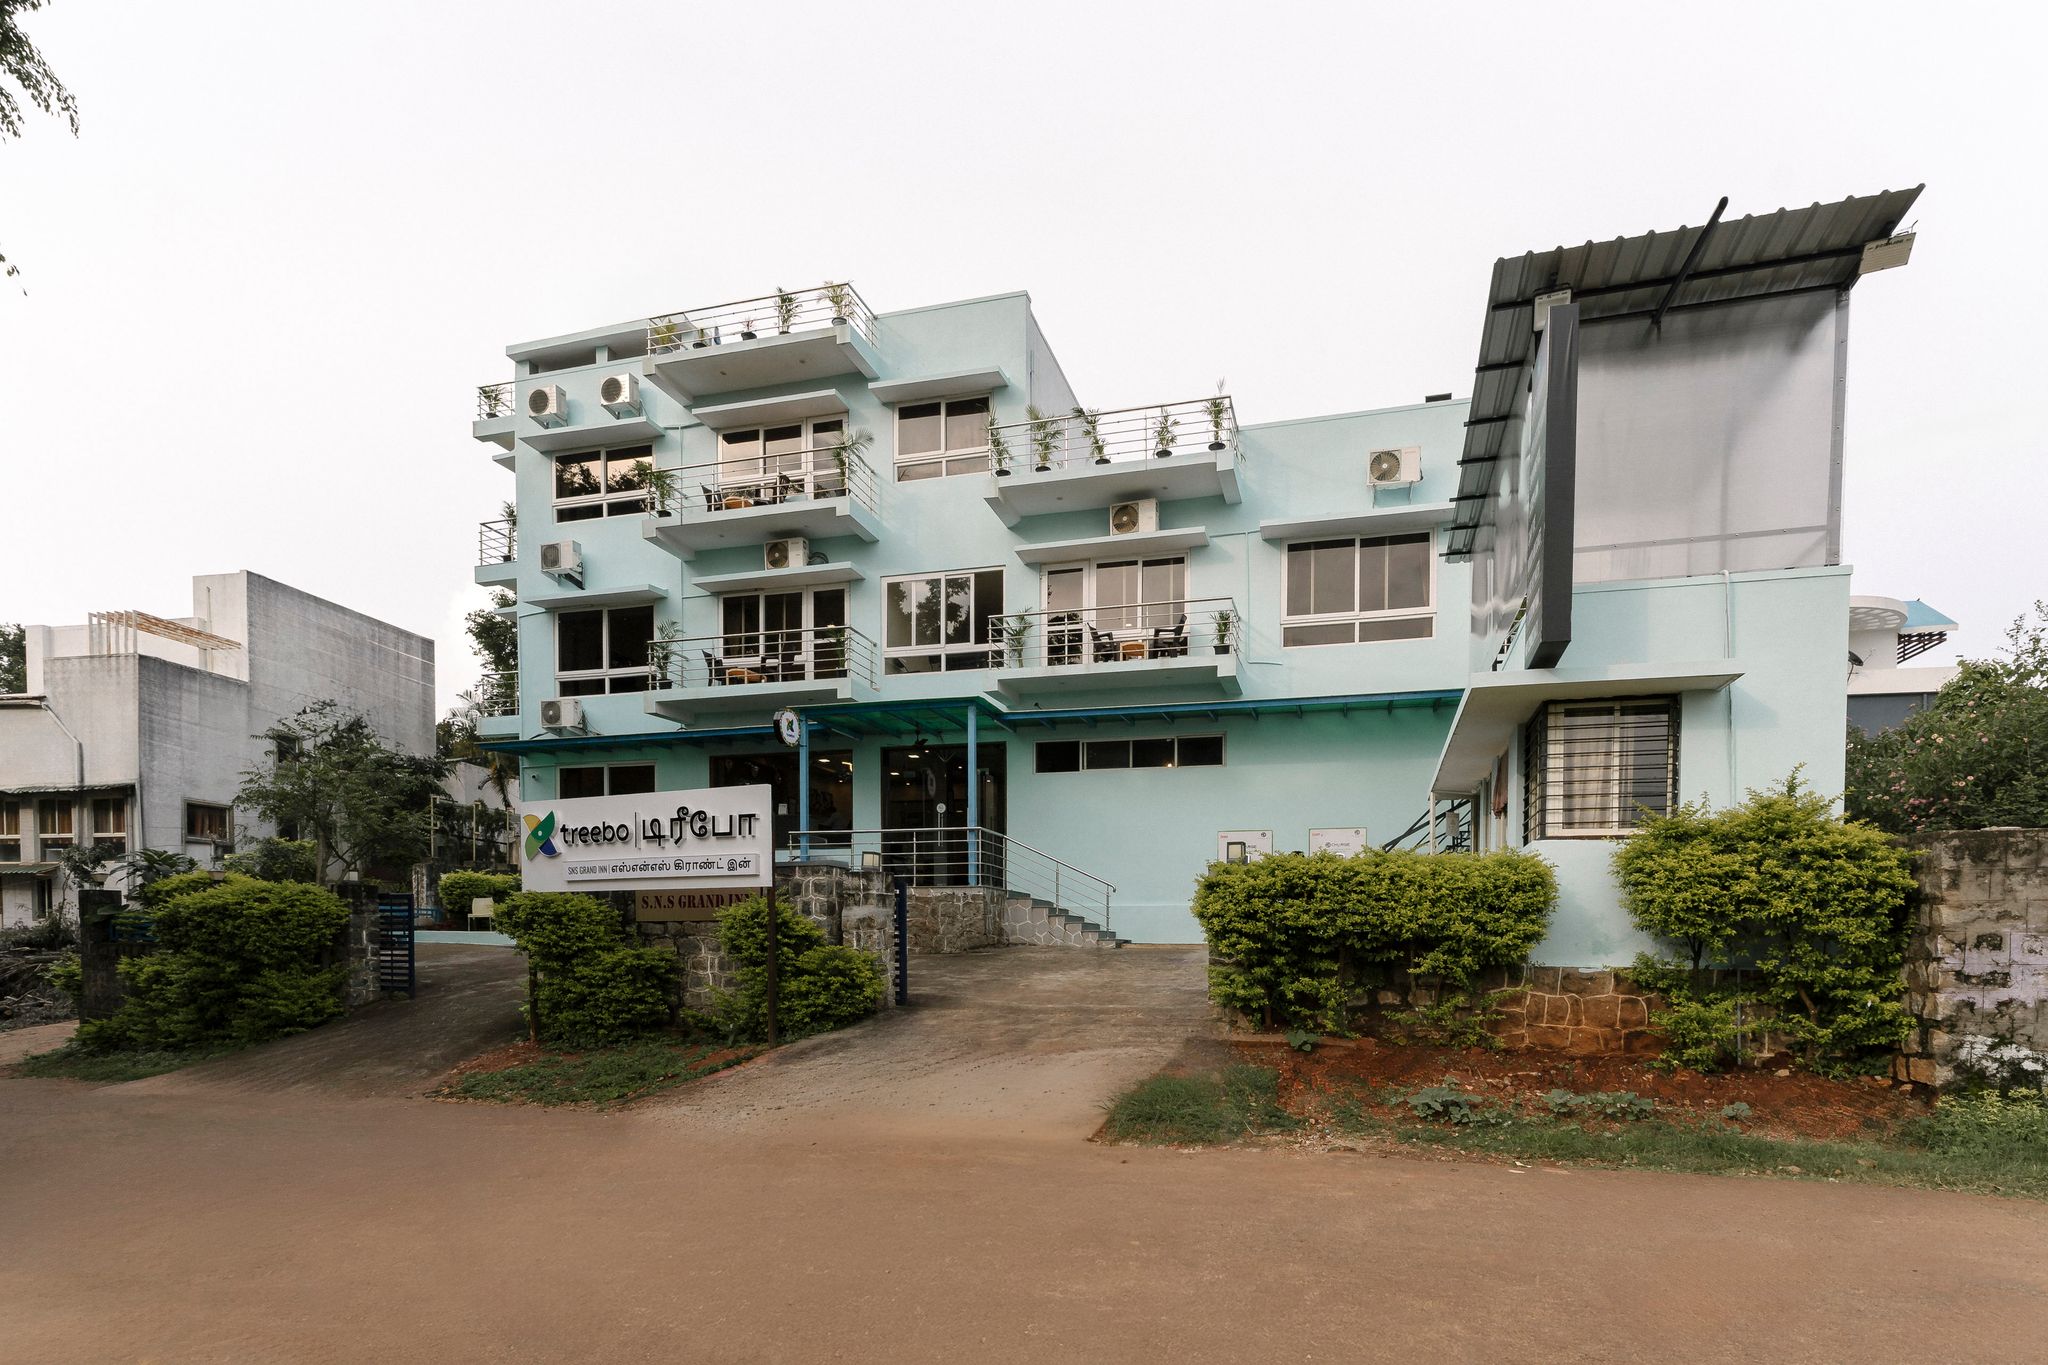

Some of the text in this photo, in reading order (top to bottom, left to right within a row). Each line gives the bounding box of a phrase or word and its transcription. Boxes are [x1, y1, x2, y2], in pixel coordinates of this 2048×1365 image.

[560, 821, 629, 844] treebo
[642, 805, 756, 846] டிரீபோ
[568, 866, 608, 875] SNS GRAND INN
[674, 858, 724, 873] கிராண்ட்
[727, 857, 751, 871] இன்
[641, 895, 675, 909] S.N.S
[678, 894, 725, 908] GRAND
